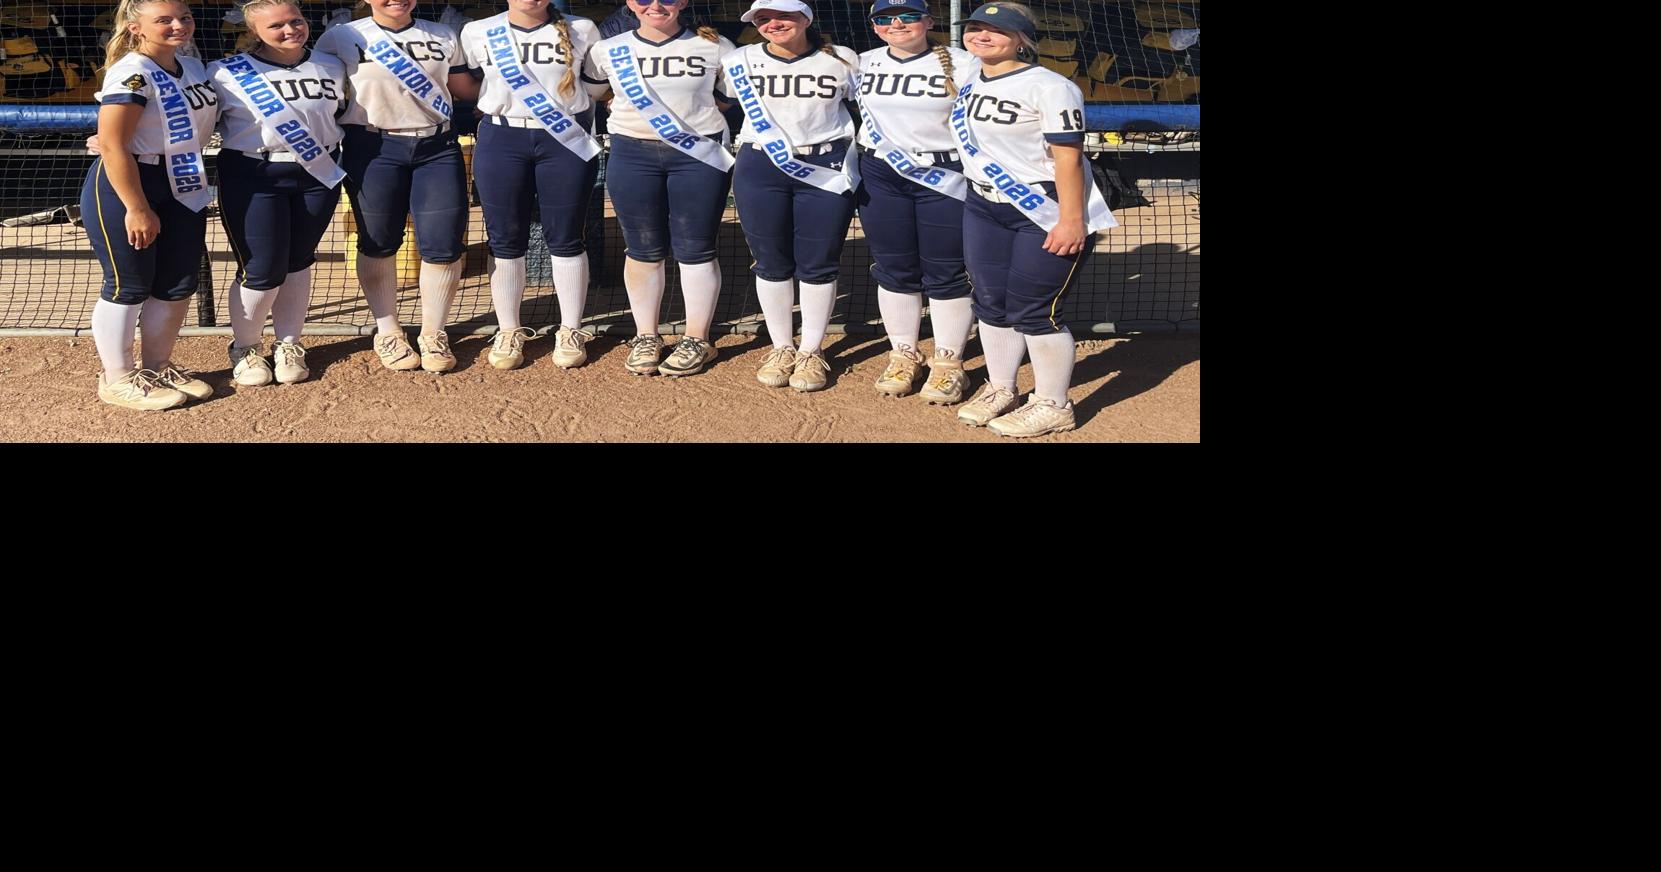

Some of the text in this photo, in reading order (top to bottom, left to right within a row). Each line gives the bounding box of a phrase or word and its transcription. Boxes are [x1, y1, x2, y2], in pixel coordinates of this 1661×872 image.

[220, 55, 323, 161] SENIOR 2026
[368, 40, 453, 119] SENIOR 20
[487, 26, 572, 133] SENIOR 2026
[609, 45, 700, 150] SENIOR 2026
[749, 75, 837, 98] BUCS
[861, 73, 953, 97] BUCS
[152, 71, 202, 193] SENIOR 2026
[729, 64, 815, 179] SENIOR 2026
[1059, 109, 1083, 131] 19
[886, 149, 946, 186] 2026
[982, 162, 1045, 211] 2026
